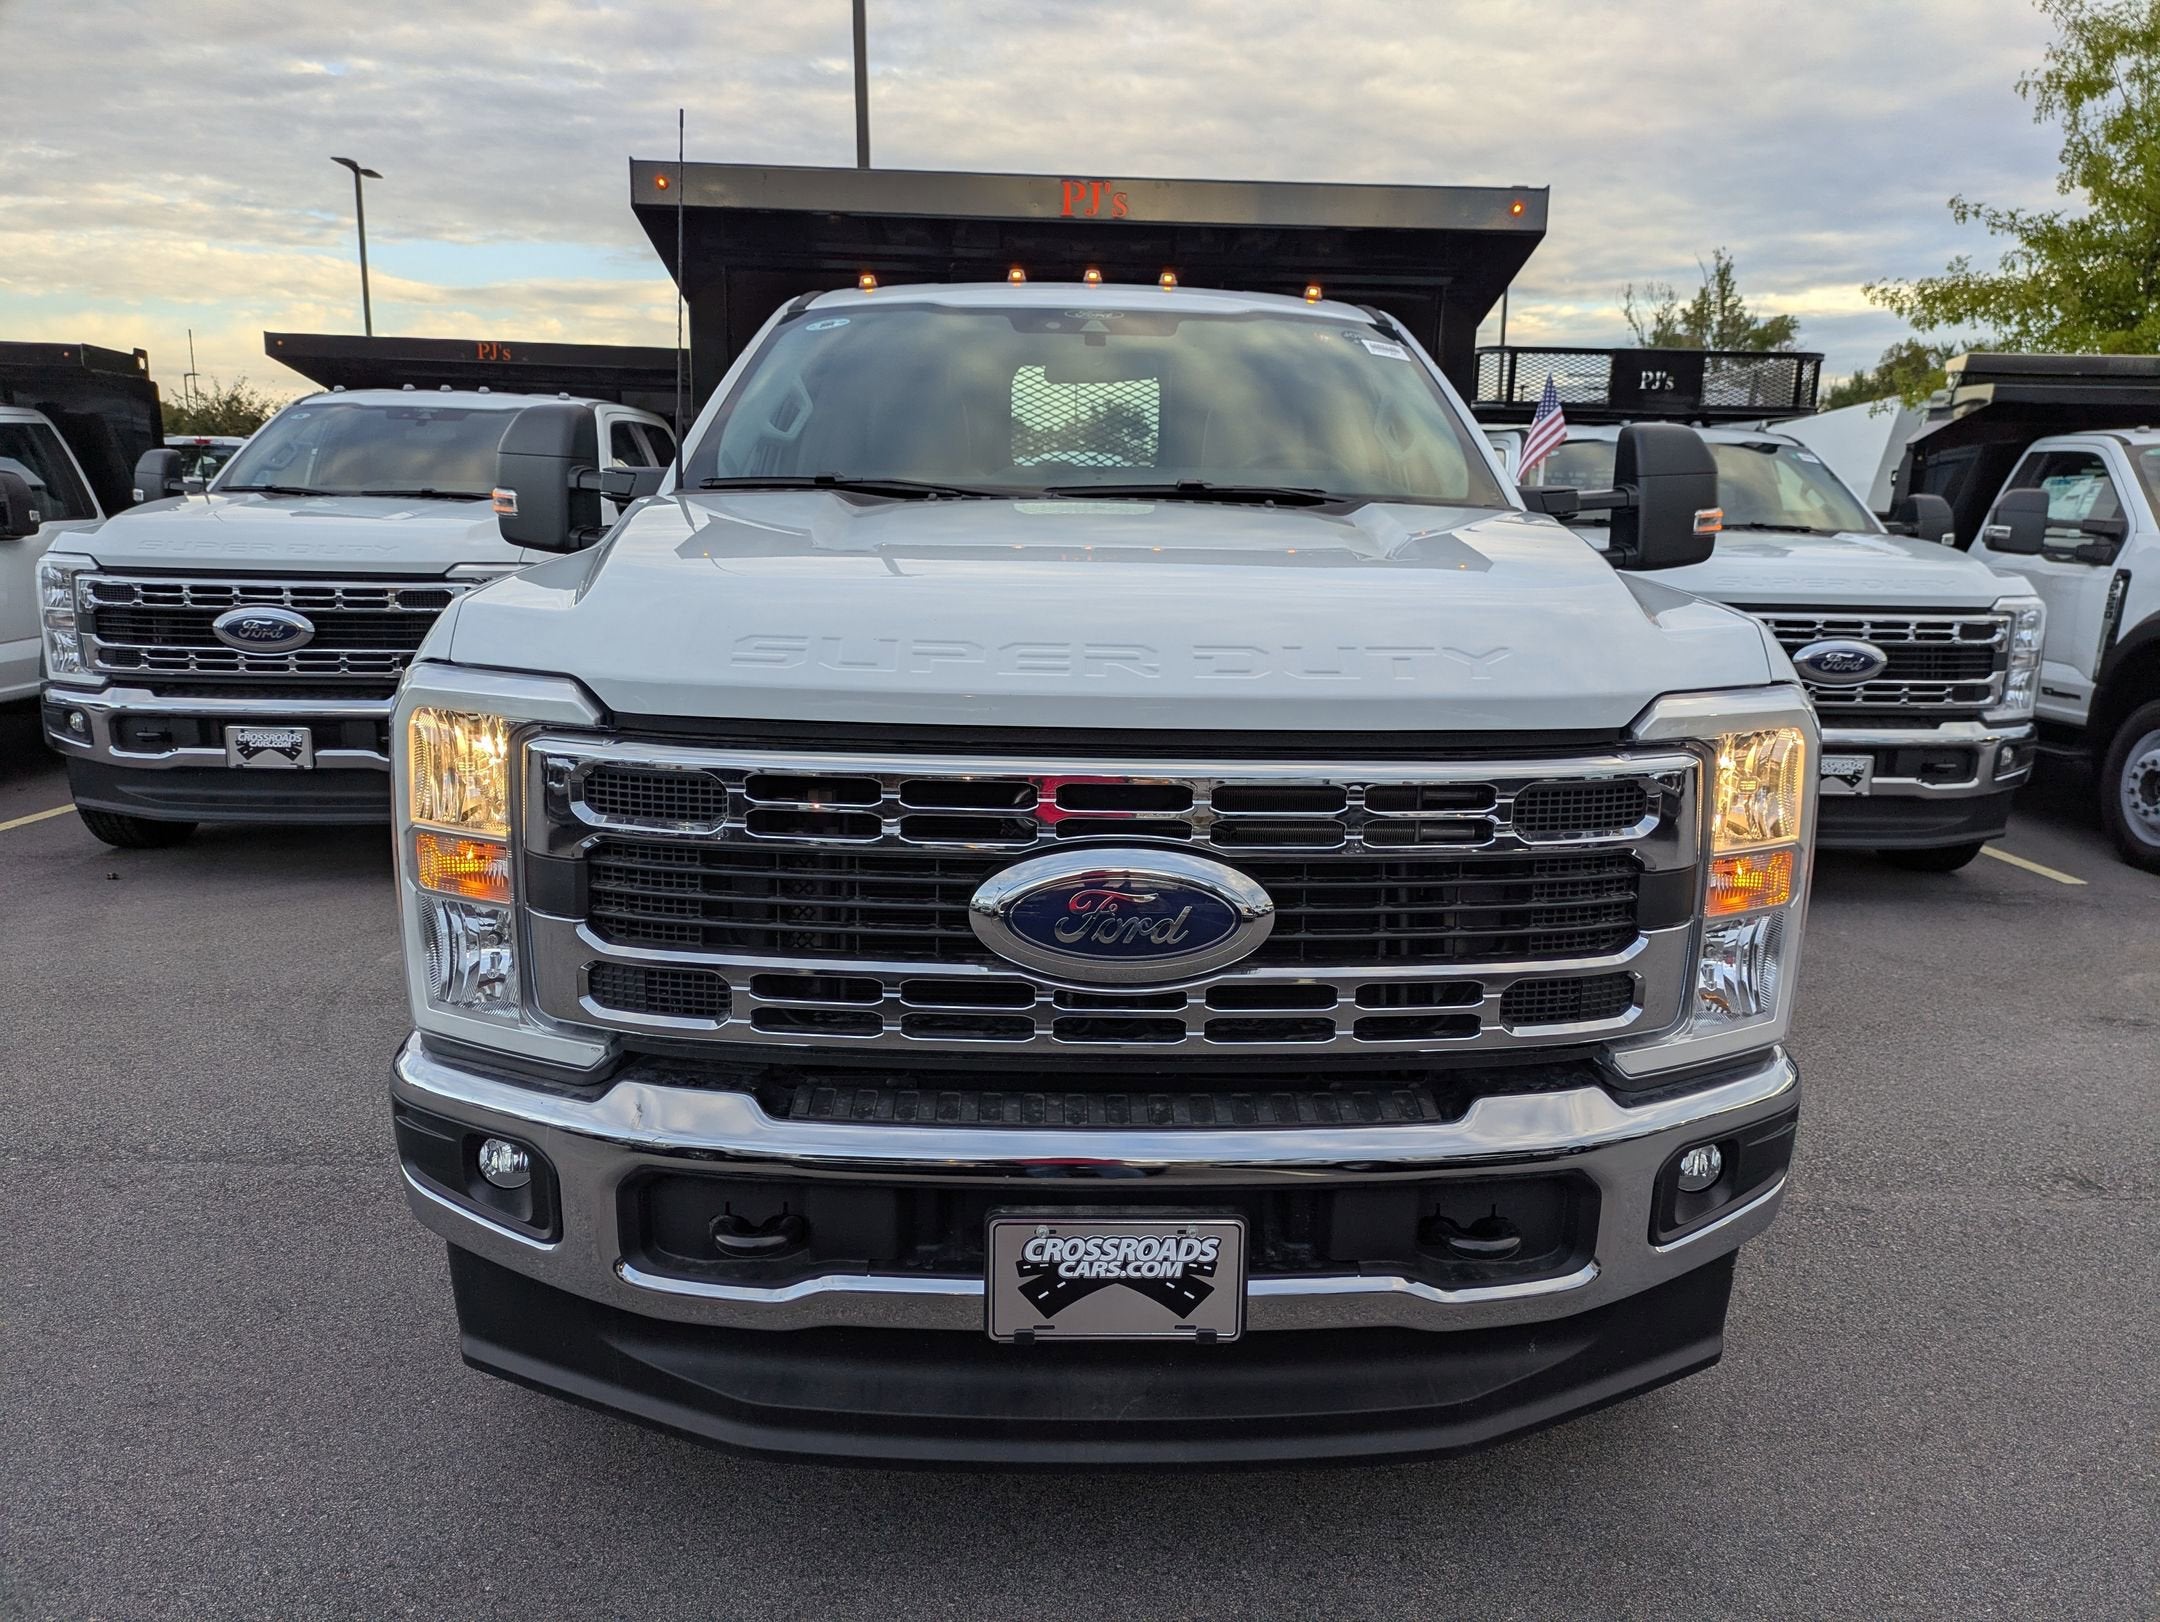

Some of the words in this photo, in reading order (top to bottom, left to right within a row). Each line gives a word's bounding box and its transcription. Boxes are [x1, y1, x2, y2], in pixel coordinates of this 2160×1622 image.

[1060, 180, 1129, 219] PJ's
[476, 341, 512, 361] PJ's
[1638, 370, 1676, 391] PJ's
[136, 539, 277, 553] SUPER
[286, 543, 401, 558] DUTY
[238, 619, 285, 639] Ford
[729, 635, 1160, 679] SUPER
[1192, 645, 1512, 680] DUTY
[1820, 652, 1865, 671] Ford
[238, 732, 303, 743] CROSSROADS
[248, 740, 292, 748] CARS.COM
[1053, 888, 1194, 945] Ford
[1022, 1236, 1222, 1264] CROSSROADS
[1057, 1260, 1184, 1279] CARS.COM
